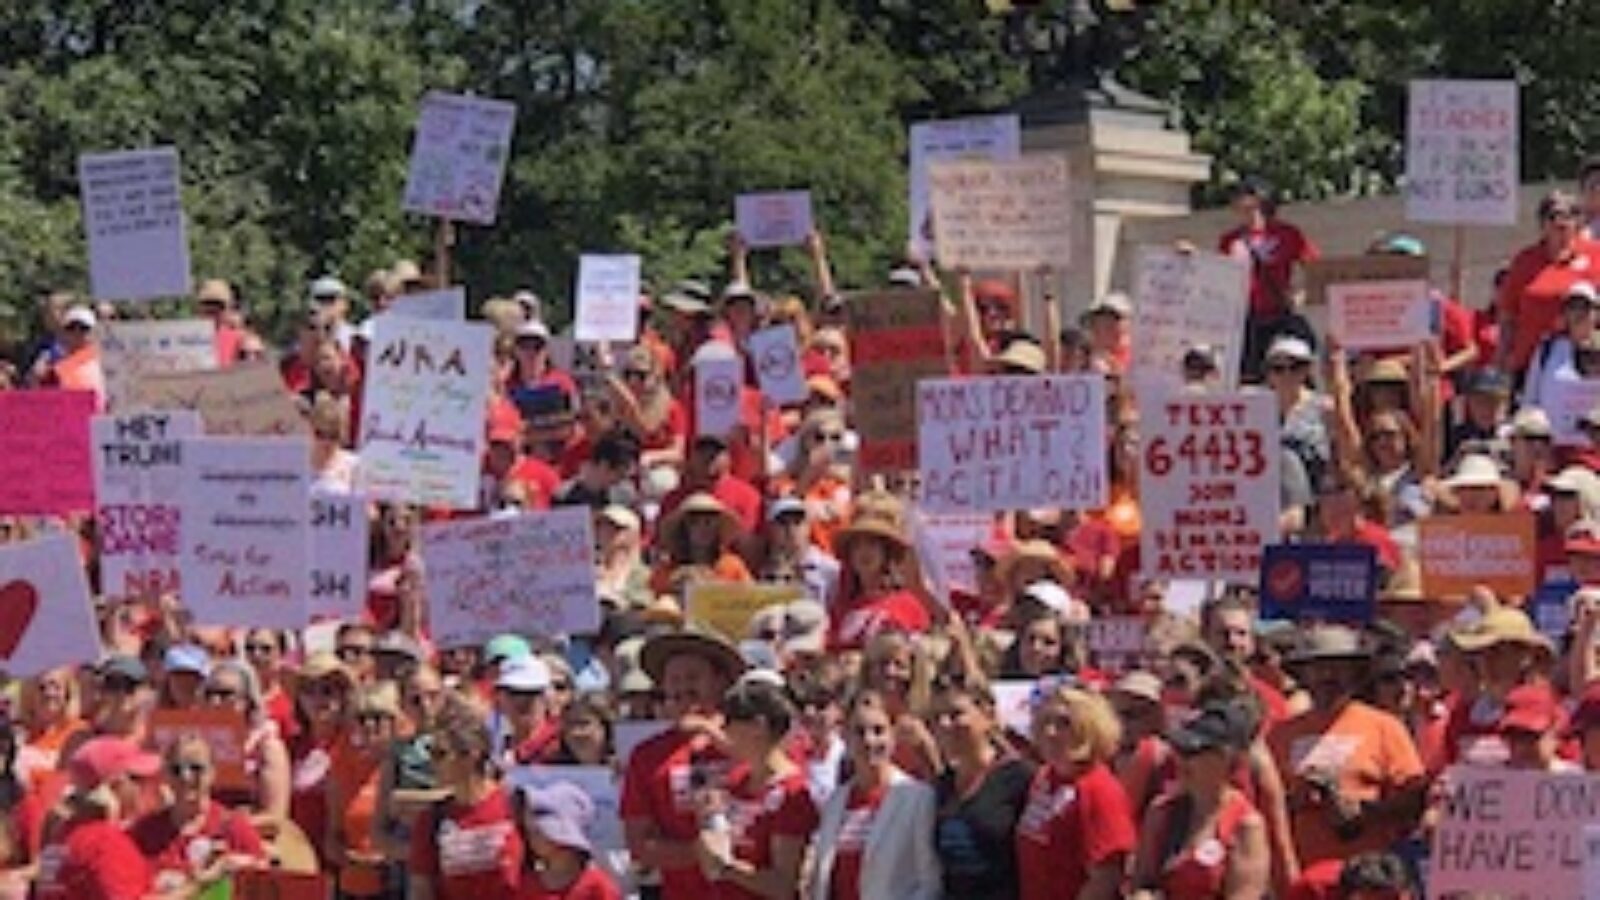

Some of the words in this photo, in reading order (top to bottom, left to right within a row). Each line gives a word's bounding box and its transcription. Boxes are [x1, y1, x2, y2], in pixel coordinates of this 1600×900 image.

[115, 413, 170, 440] HEY
[1166, 403, 1247, 427] TEXT
[1147, 430, 1267, 477] 64433
[1189, 483, 1236, 503] JOIN
[1174, 505, 1247, 526] MOMS
[1155, 528, 1261, 550] DEMAND
[1443, 779, 1504, 821] WE
[1439, 830, 1535, 871] HAVE
